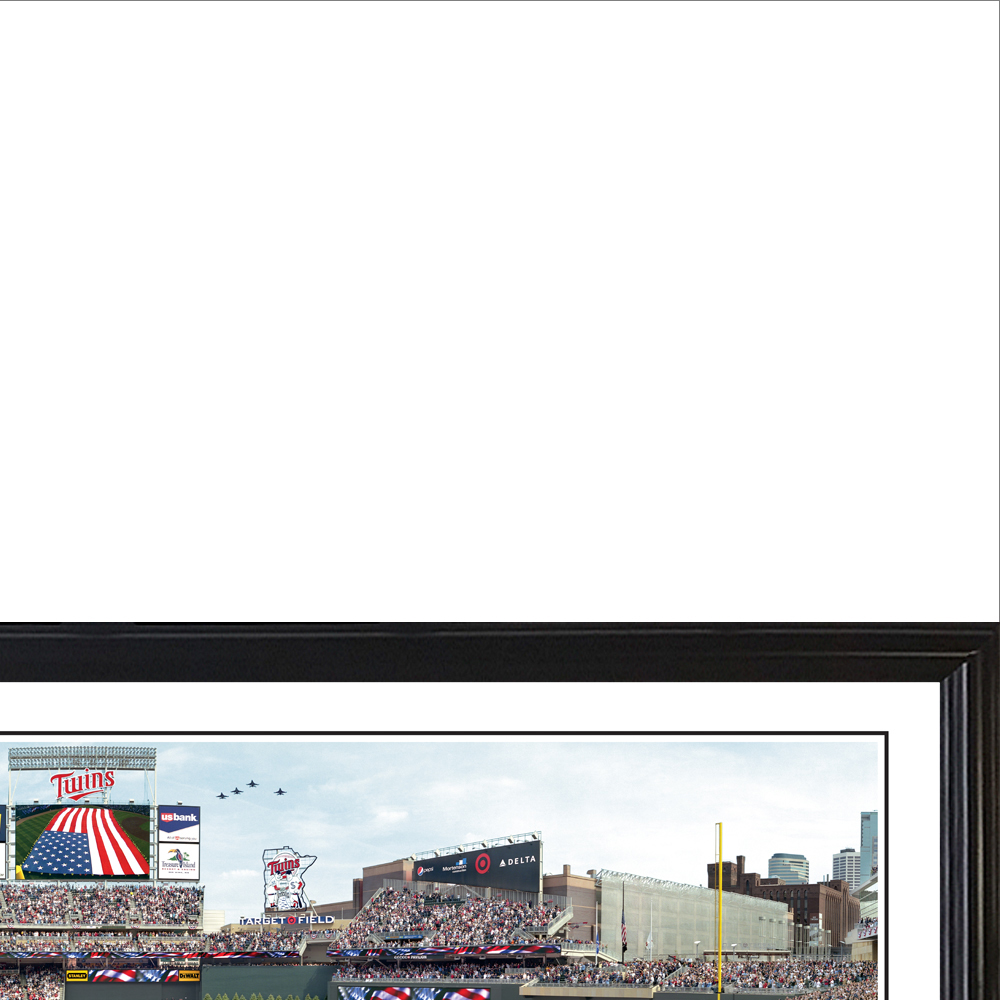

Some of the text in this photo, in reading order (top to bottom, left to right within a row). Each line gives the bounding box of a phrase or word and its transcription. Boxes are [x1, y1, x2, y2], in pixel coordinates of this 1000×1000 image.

[50, 768, 115, 801] Twins
[267, 858, 301, 876] Twins
[507, 855, 536, 866] DELTA
[298, 916, 335, 924] FIELD
